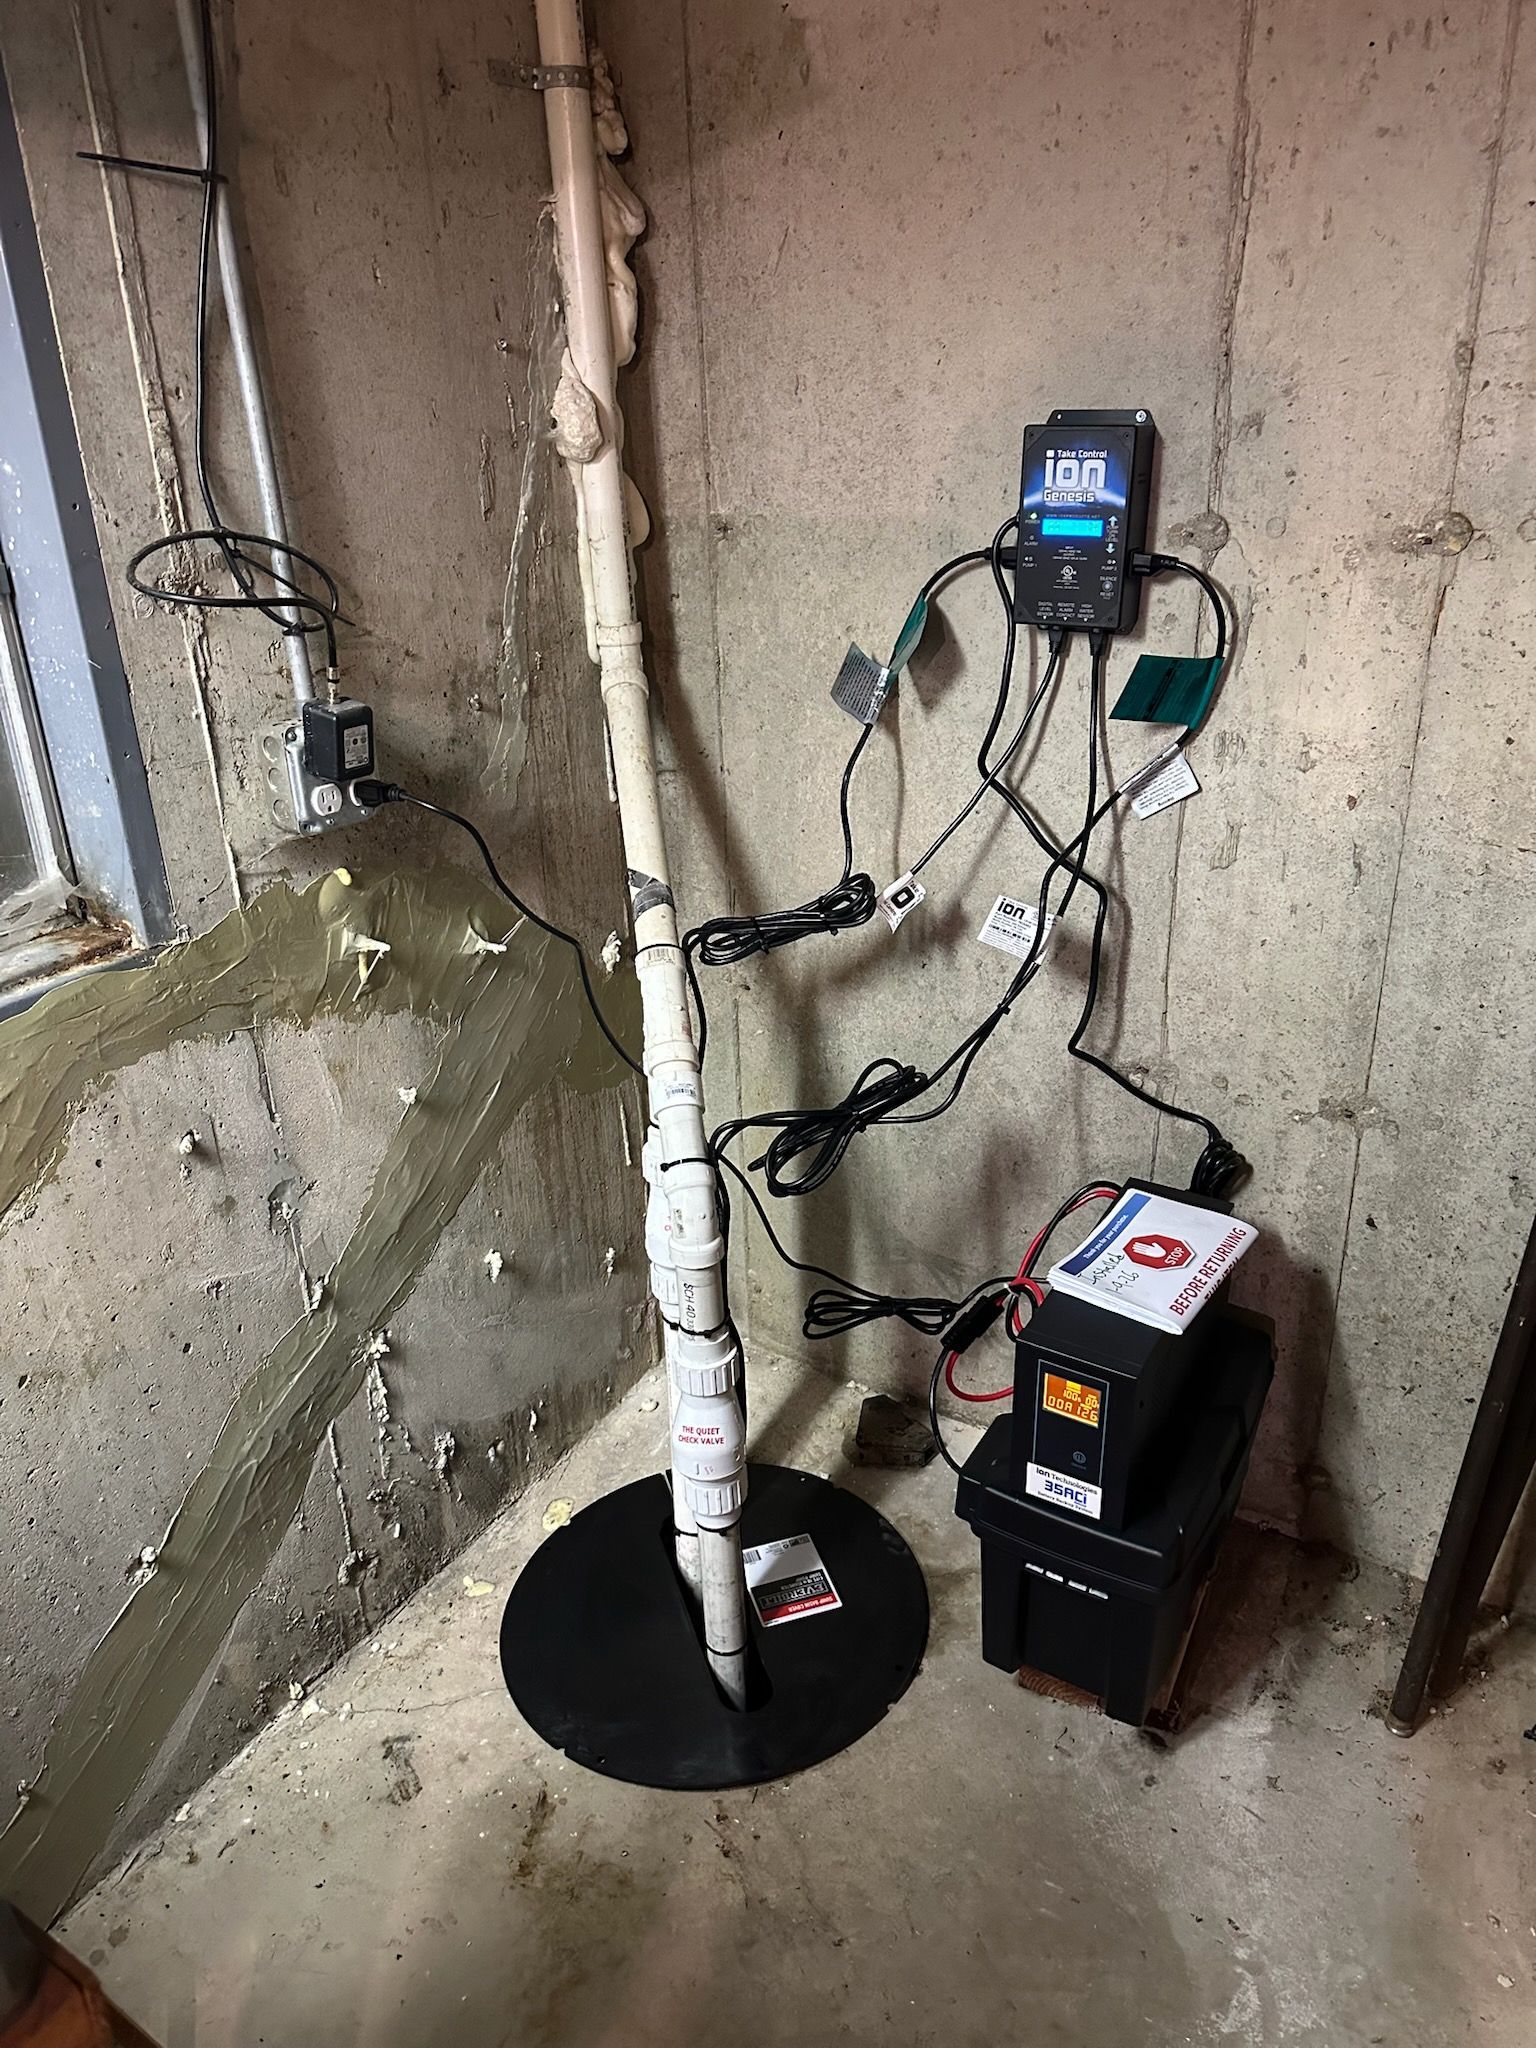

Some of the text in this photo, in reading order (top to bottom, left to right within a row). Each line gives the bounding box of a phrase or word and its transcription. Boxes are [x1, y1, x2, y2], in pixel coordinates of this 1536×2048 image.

[1057, 450, 1107, 458] Take Control
[1045, 450, 1106, 488] ion
[1044, 490, 1094, 502] Genesis
[998, 898, 1025, 919] ion
[1164, 1246, 1185, 1266] STOP
[1169, 1275, 1208, 1316] BEFORE
[1198, 1227, 1247, 1280] RETURNING
[684, 1283, 695, 1303] SCH
[686, 1305, 696, 1319] 40
[678, 1435, 699, 1444] CHECK
[682, 1426, 720, 1436] THE QUIET
[1044, 1480, 1087, 1504] 35ACi
[1051, 1473, 1098, 1495] Technologies
[788, 1596, 834, 1612] SUMP BASIN COVER
